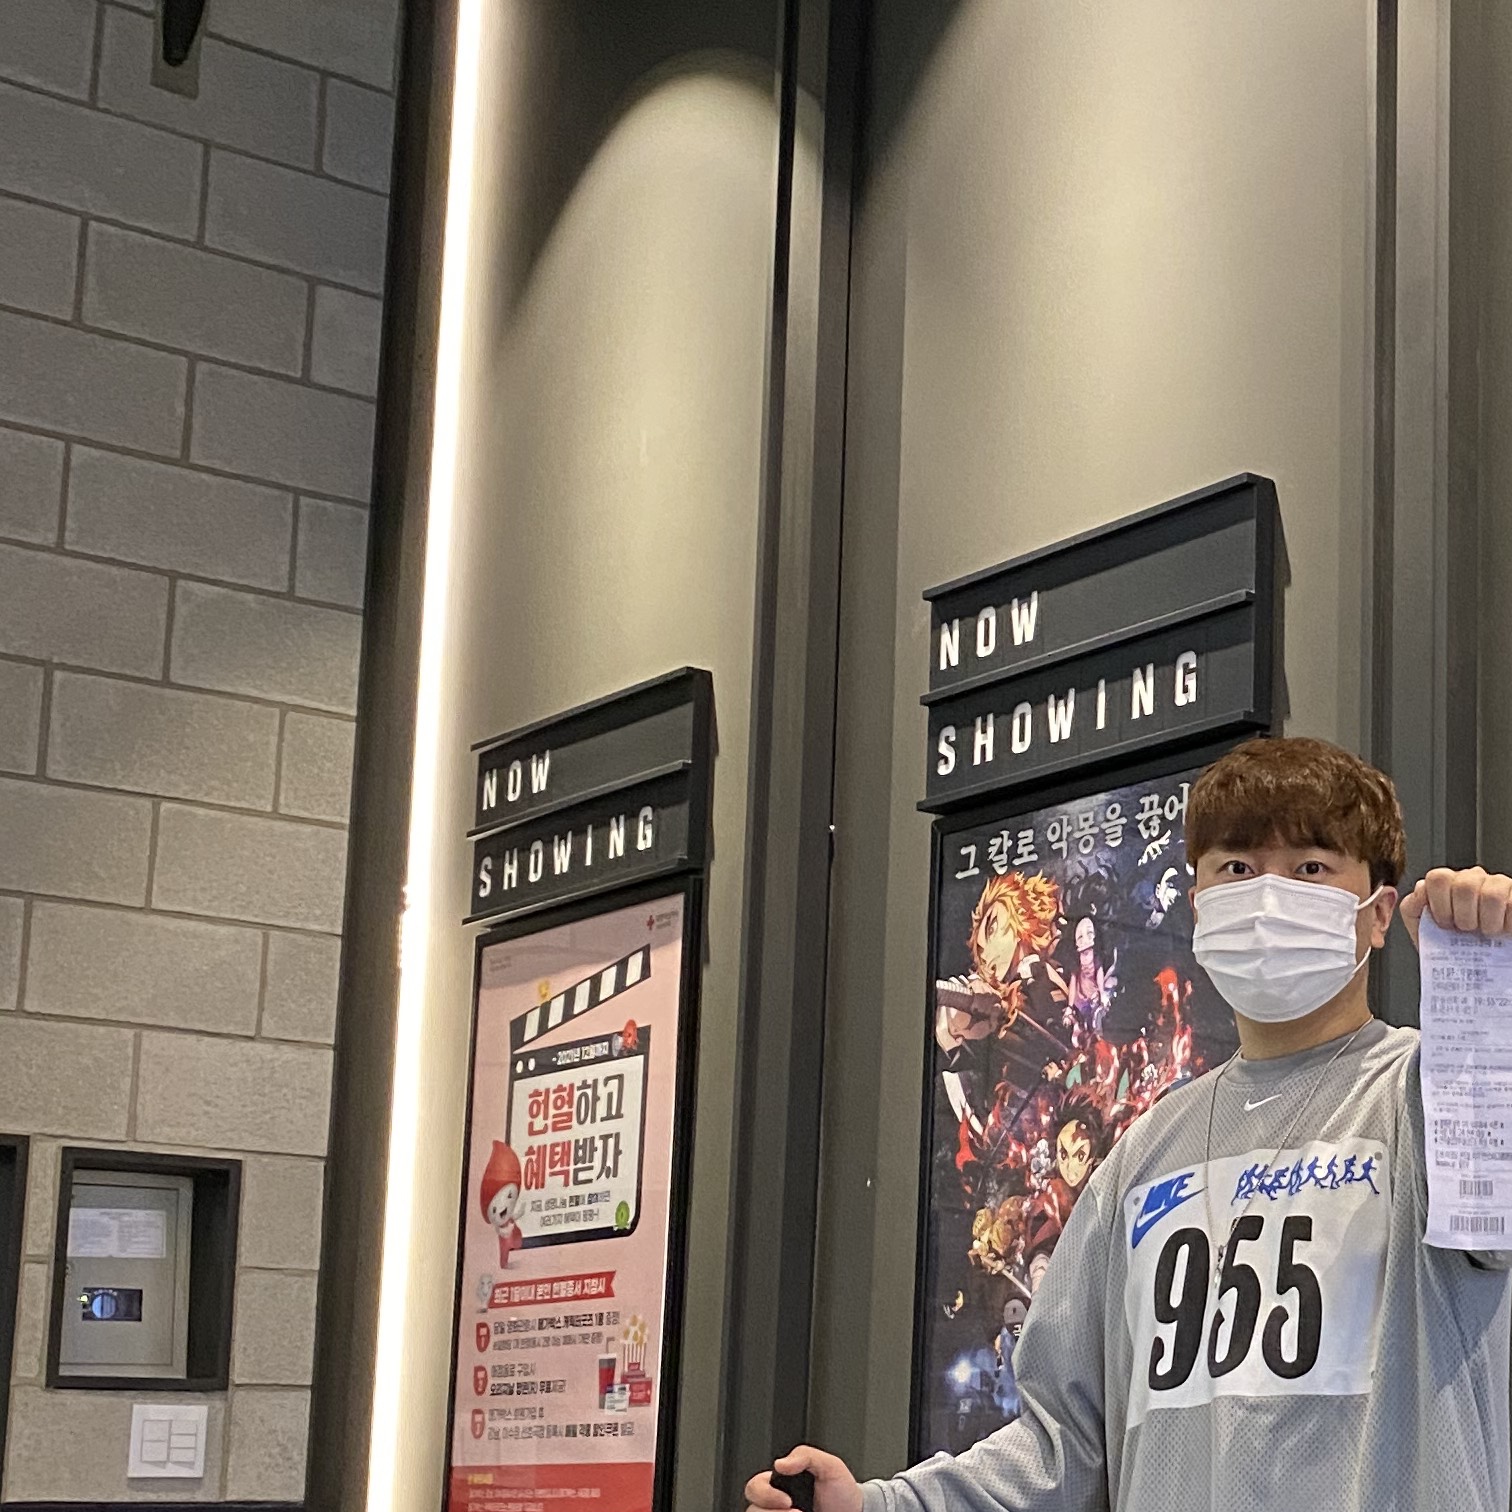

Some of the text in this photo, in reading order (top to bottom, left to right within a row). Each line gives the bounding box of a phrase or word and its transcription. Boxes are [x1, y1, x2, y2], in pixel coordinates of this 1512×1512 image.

[940, 591, 1038, 671] NOW
[937, 650, 1197, 776] SHOWING
[483, 749, 551, 811] NOW
[479, 806, 655, 898] SHOWING
[955, 845, 980, 880] 그
[987, 829, 1039, 874] 칼로
[1046, 803, 1128, 860] 악몽을
[527, 1073, 625, 1137] 헌혈하고
[524, 1132, 623, 1191] 혜택받자
[1149, 1215, 1323, 1391] 955
